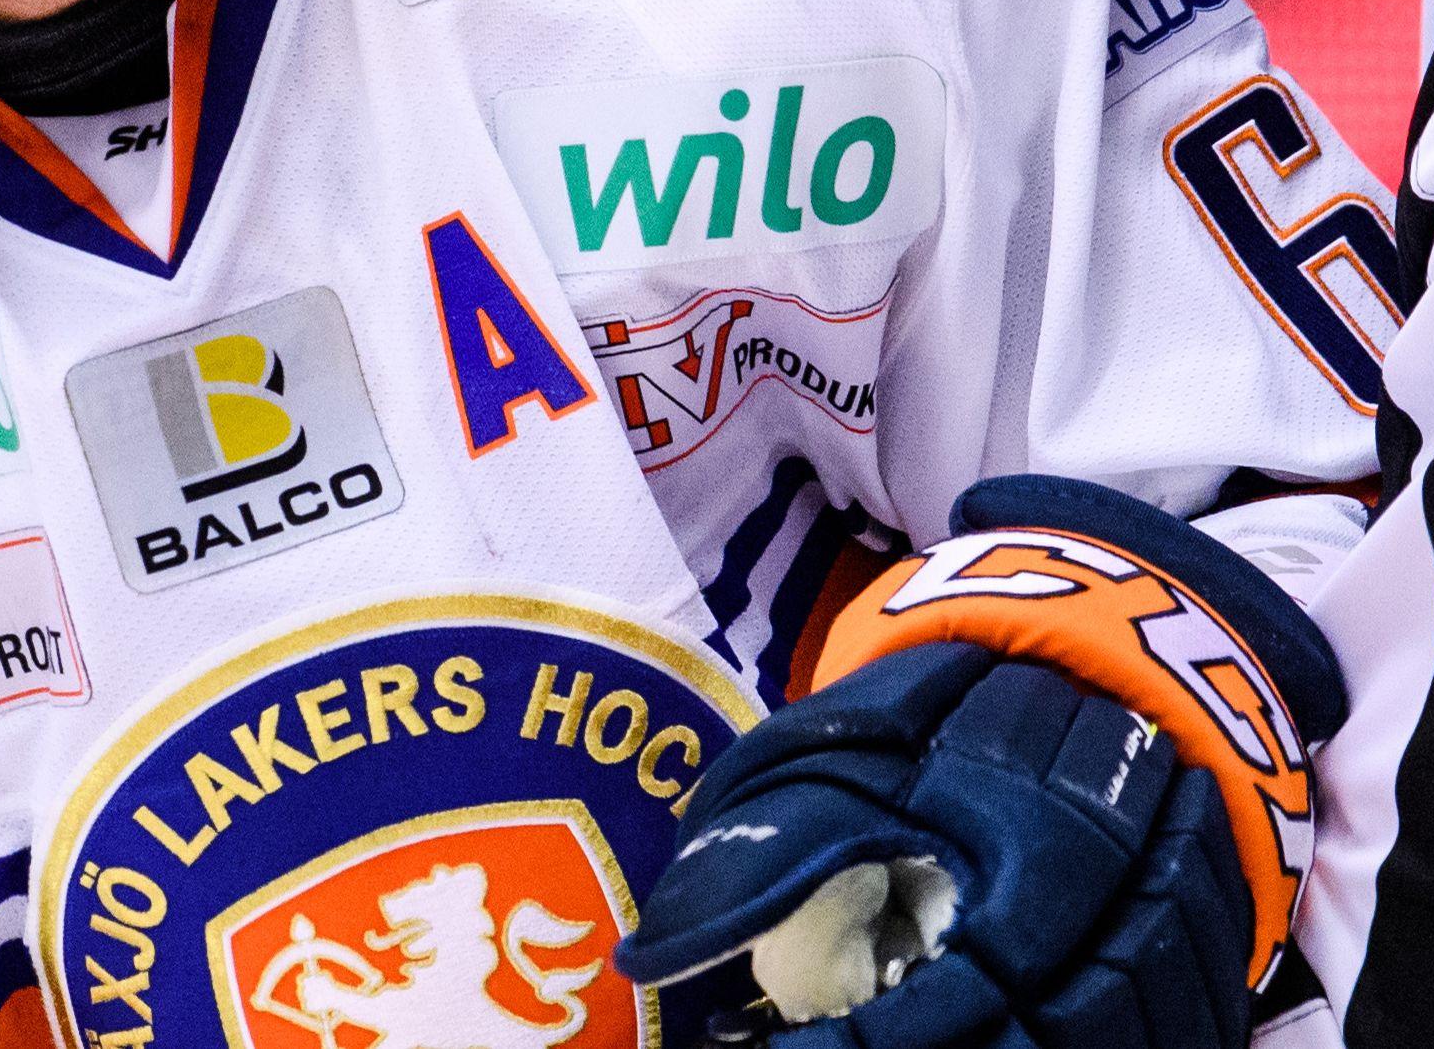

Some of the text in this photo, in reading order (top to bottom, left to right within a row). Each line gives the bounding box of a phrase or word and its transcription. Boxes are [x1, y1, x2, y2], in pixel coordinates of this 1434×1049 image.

[559, 84, 896, 252] wilo
[421, 209, 598, 459] A
[135, 463, 383, 575] BALCO
[132, 654, 486, 868] LAKERS
[520, 662, 702, 817] HOC
